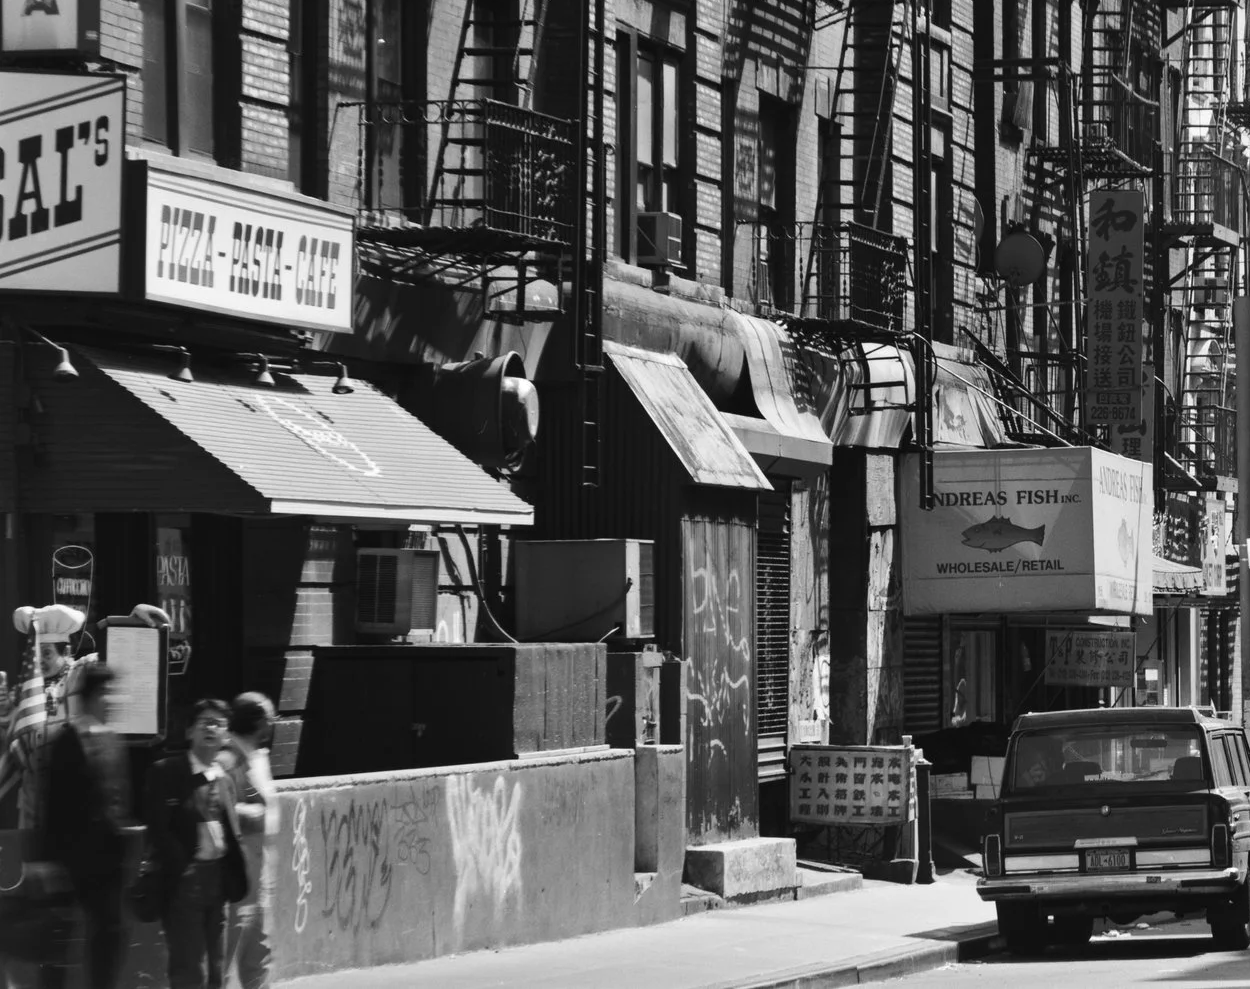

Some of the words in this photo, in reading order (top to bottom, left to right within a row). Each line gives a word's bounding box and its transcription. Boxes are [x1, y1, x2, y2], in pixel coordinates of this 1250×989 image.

[157, 204, 217, 289] PIZZA
[229, 220, 284, 302] PASTA
[296, 234, 341, 310] CAFE
[918, 490, 1008, 508] NDREAS
[1016, 489, 1060, 506] FISH
[1061, 494, 1083, 505] INC.
[156, 555, 191, 587] PASTA
[935, 558, 1066, 575] WHOLESALE/RETAIL
